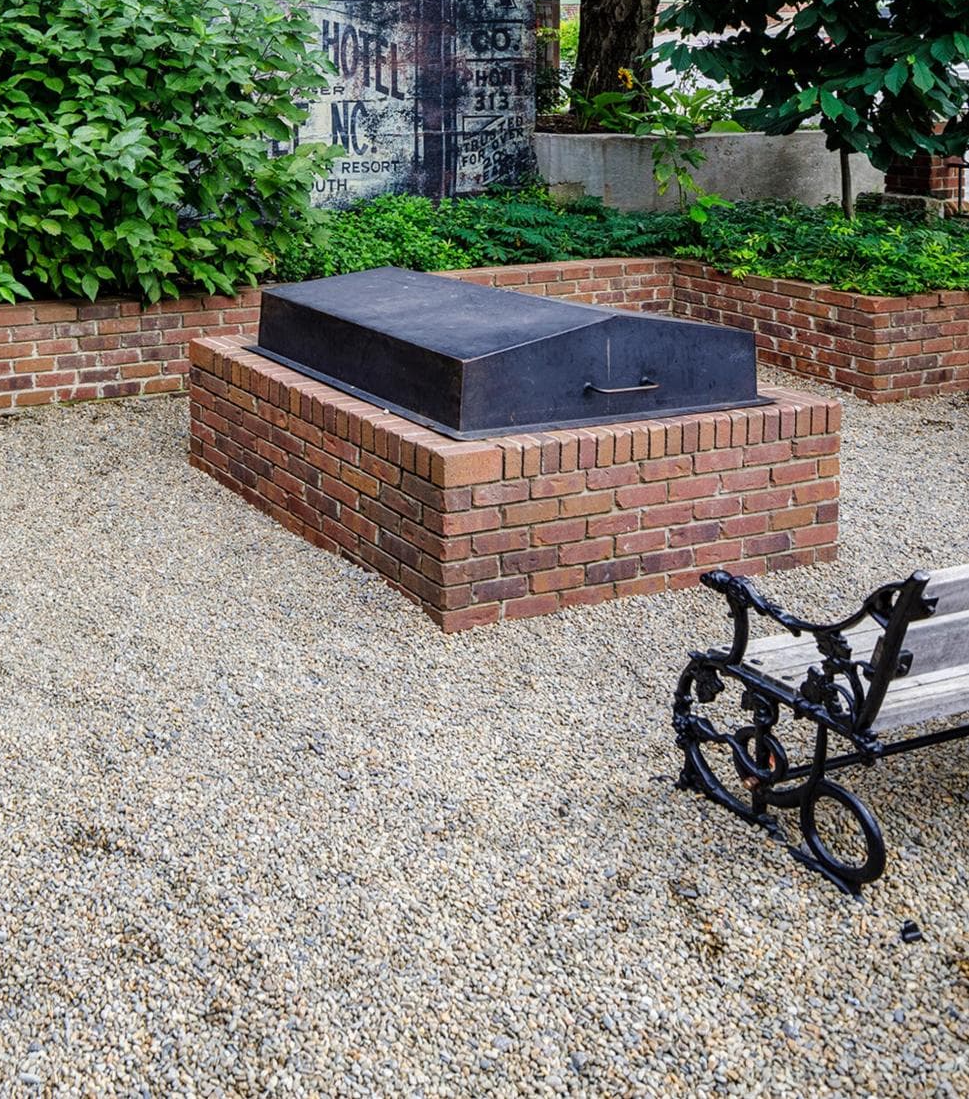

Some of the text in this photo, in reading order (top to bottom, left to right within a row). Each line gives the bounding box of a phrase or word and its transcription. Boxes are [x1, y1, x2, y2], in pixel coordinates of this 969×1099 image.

[471, 27, 521, 53] CO.
[322, 18, 405, 101] HOTEL
[475, 90, 510, 112] 313
[461, 127, 525, 168] FOR OVER
[341, 160, 400, 175] RESORT
